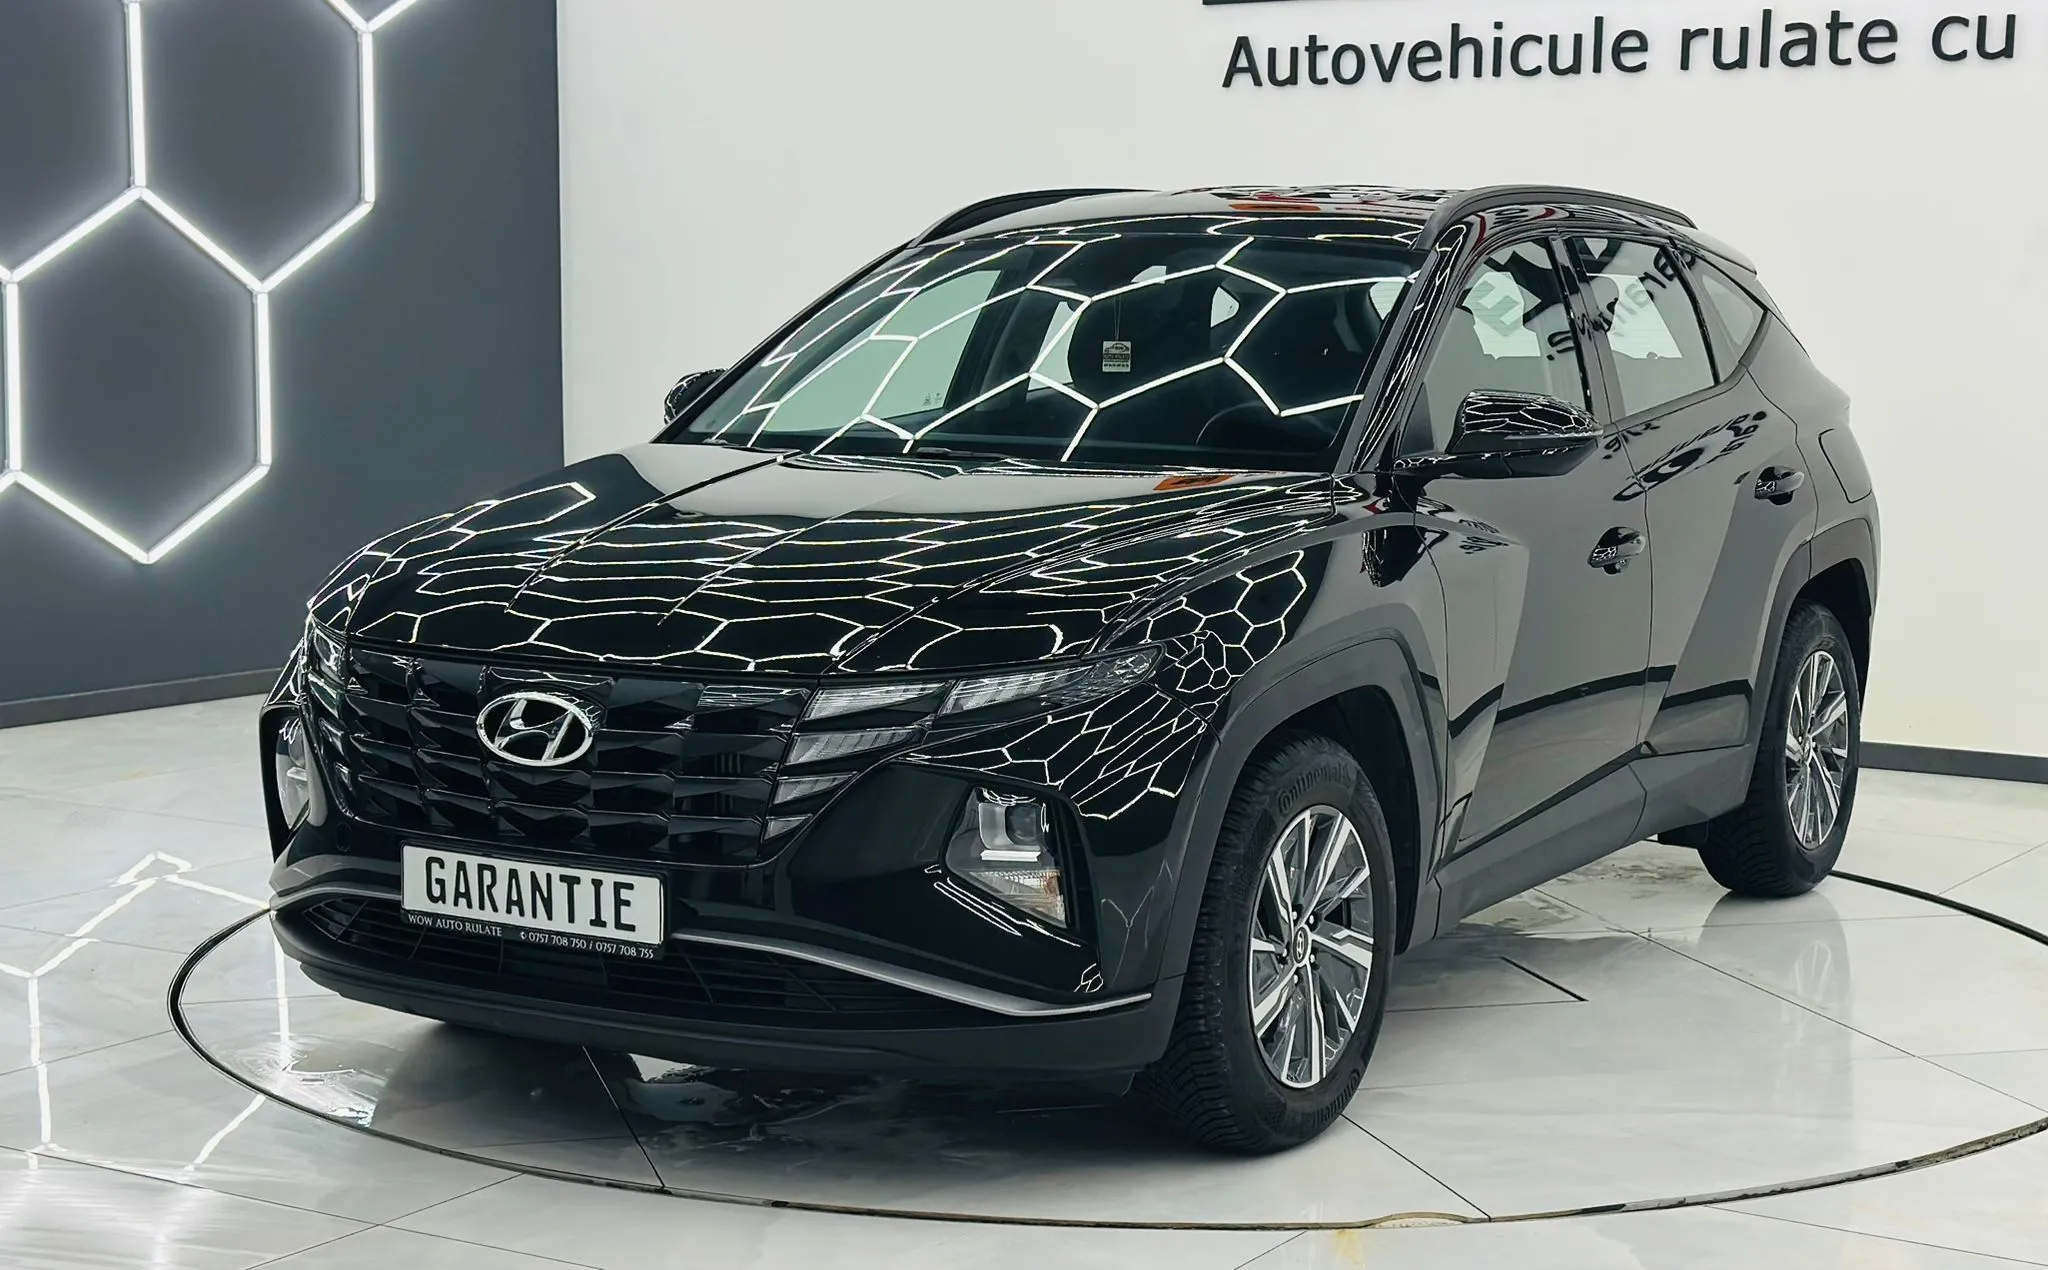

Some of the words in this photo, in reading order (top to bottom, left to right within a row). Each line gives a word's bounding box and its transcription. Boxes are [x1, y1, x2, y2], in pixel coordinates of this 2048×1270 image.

[1221, 15, 1649, 88] Autovehicule
[1679, 8, 1898, 71] rulate
[1931, 13, 2016, 62] cu
[425, 856, 636, 932] GARANTIE
[407, 913, 433, 926] WOW
[435, 918, 463, 931] AUTO
[465, 922, 502, 937] RULATE
[528, 931, 549, 944] 0757
[551, 934, 569, 947] 708
[570, 937, 587, 950] 750
[595, 941, 617, 954] 0757
[619, 945, 637, 957] 708
[639, 947, 654, 959] 755
